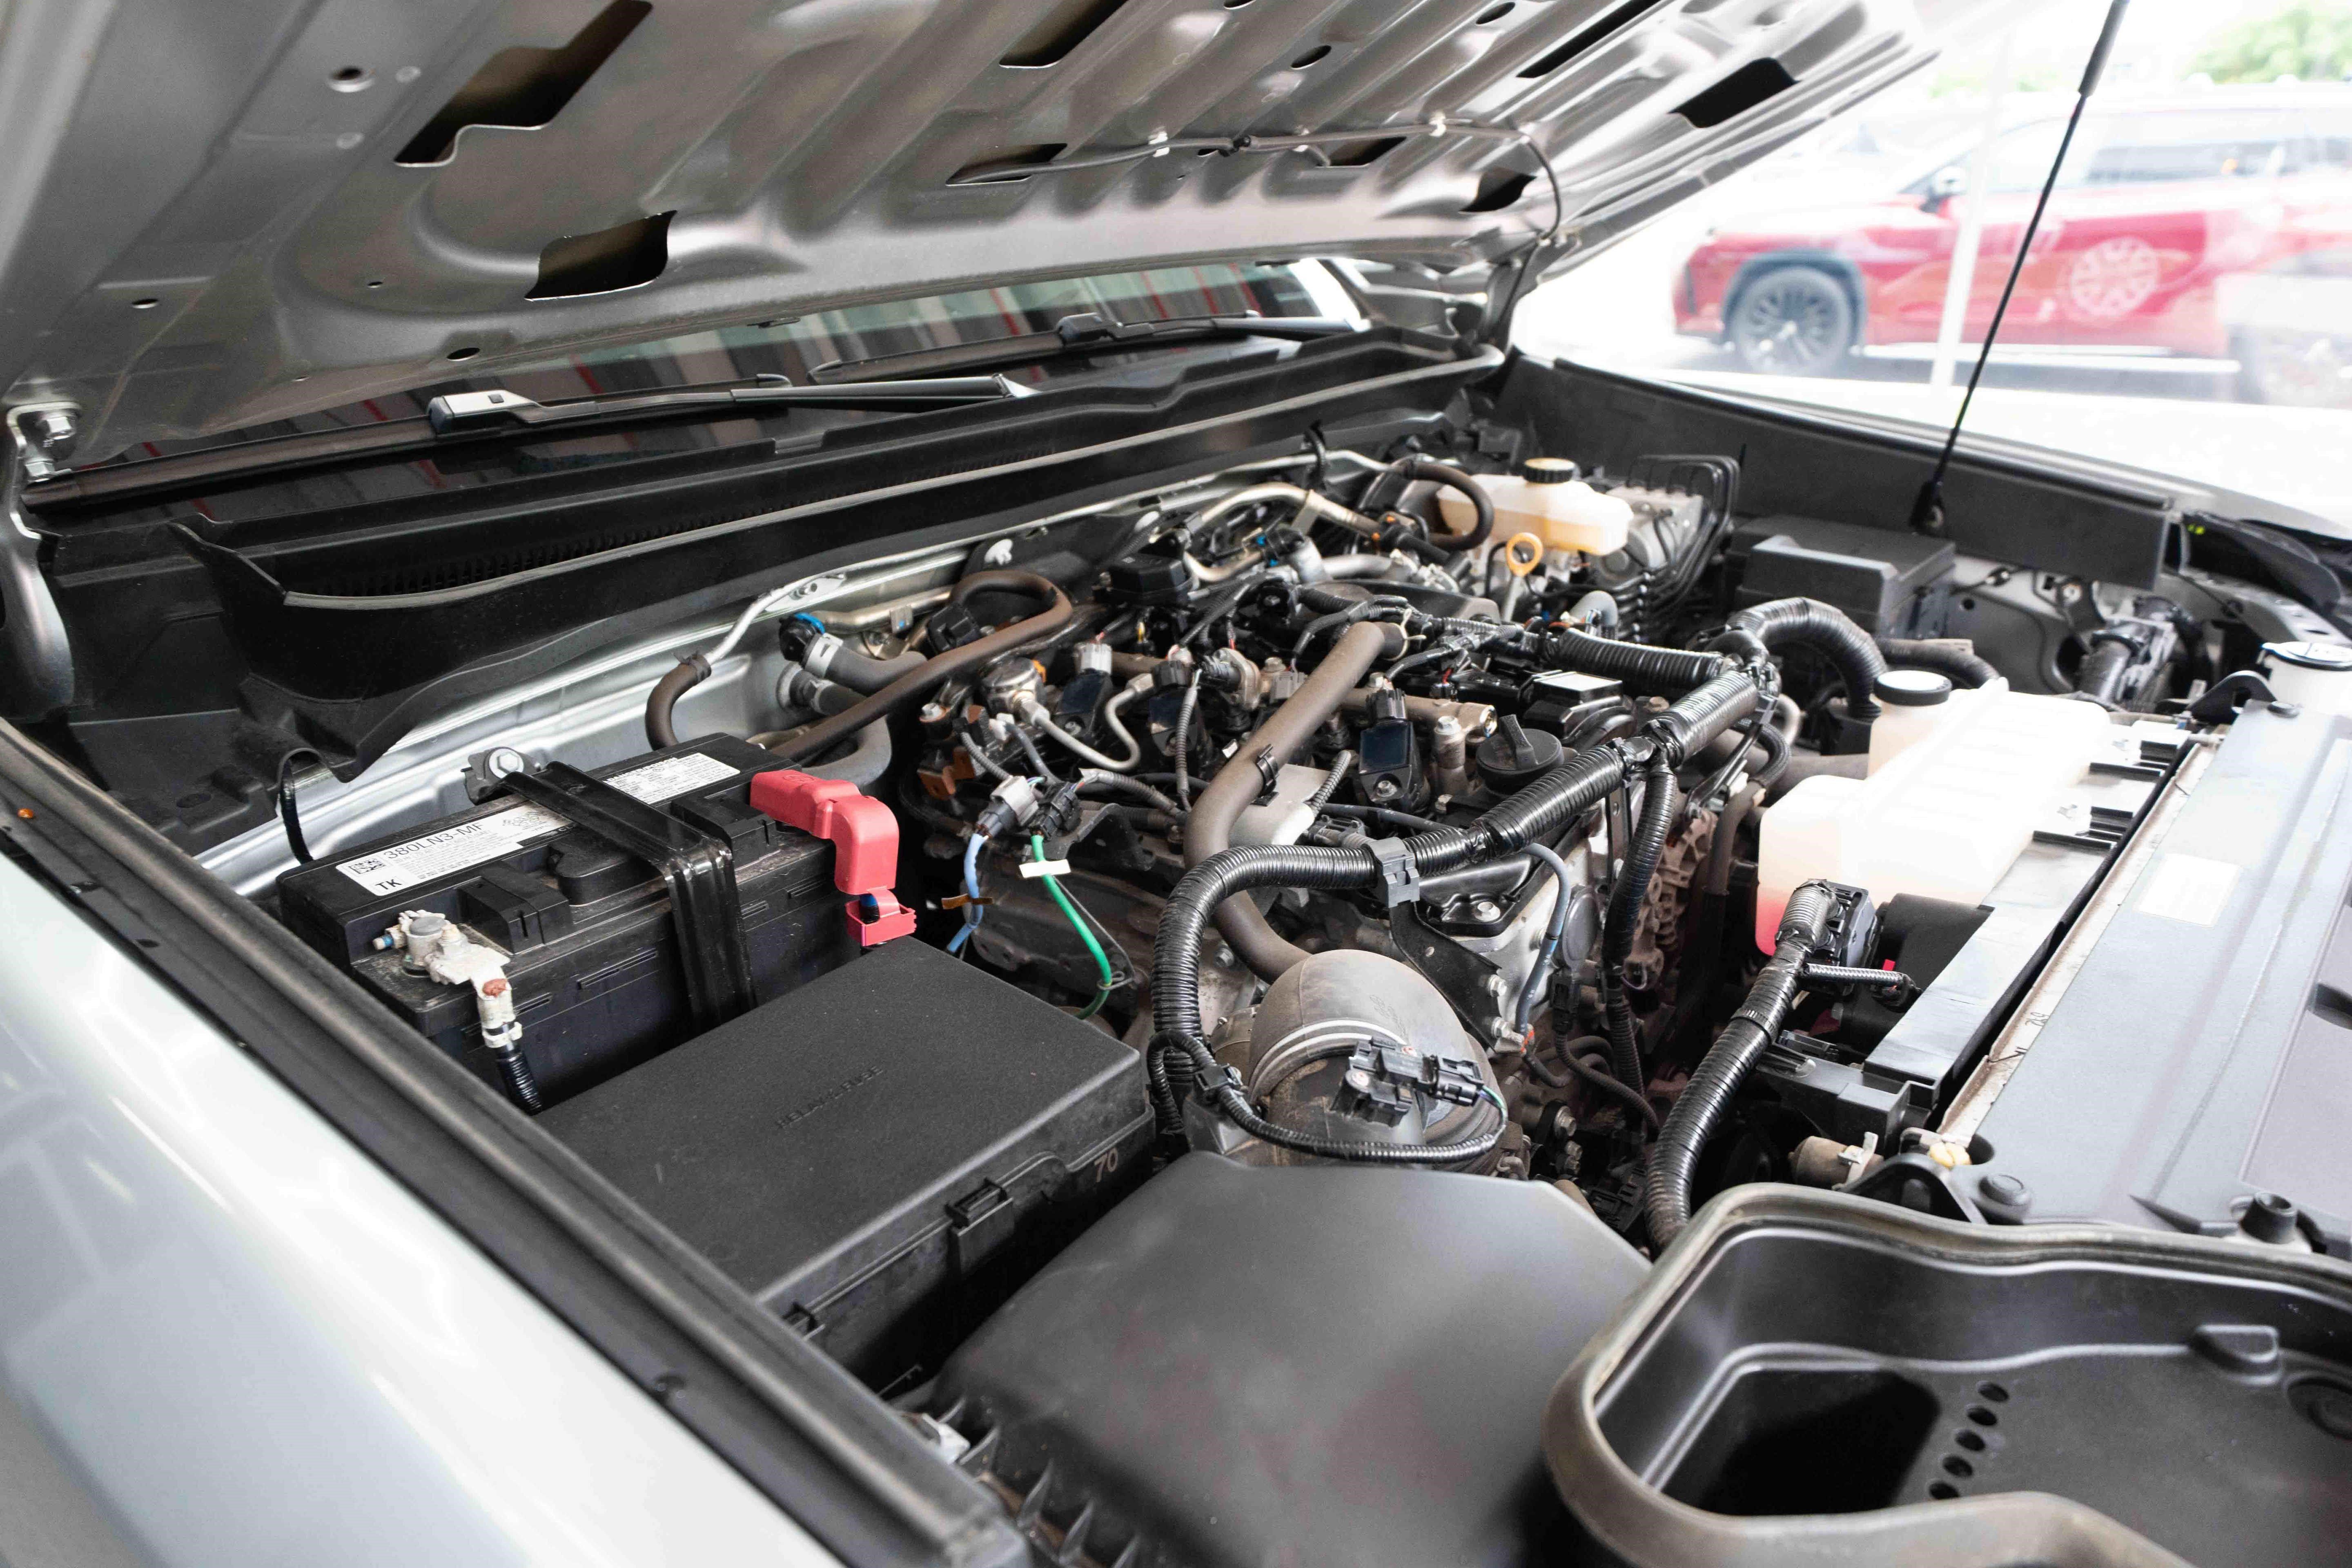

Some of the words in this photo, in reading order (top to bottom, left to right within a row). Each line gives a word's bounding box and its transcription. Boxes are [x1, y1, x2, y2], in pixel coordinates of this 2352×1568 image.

[383, 822, 485, 860] 380LN3-MF
[375, 878, 403, 891] TK
[1094, 1147, 1118, 1183] 70
